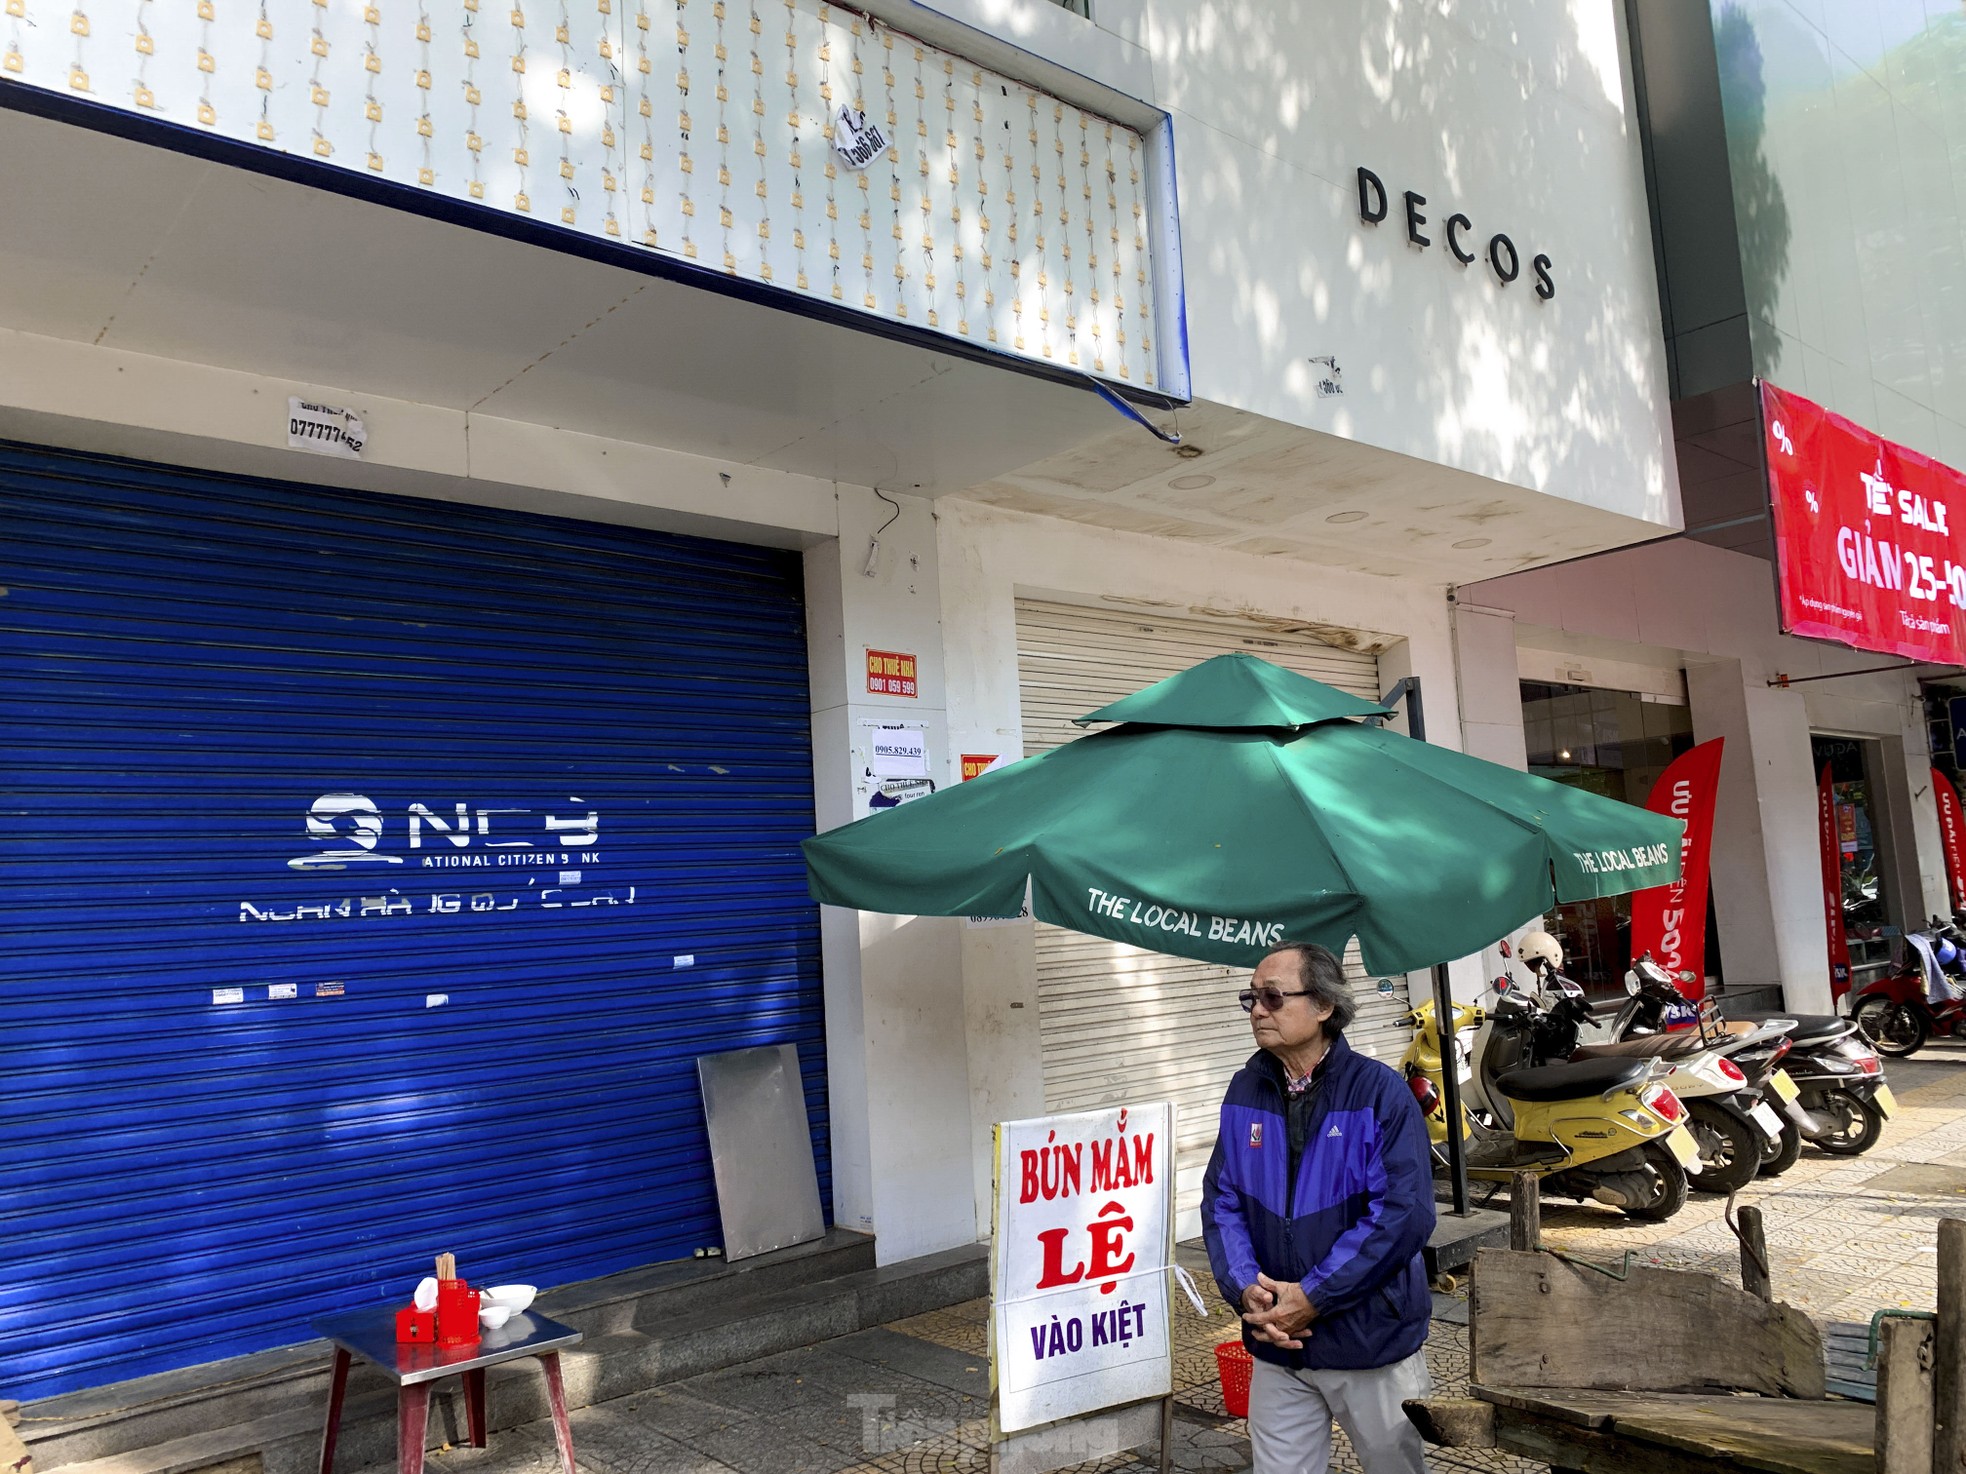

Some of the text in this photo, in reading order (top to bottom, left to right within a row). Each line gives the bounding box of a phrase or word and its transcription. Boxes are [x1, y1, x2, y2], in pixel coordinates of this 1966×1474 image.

[1357, 167, 1555, 300] DECOS
[1772, 420, 1793, 455] %
[1805, 490, 1819, 513] %
[1898, 490, 1949, 536] SALE
[869, 656, 883, 674] CHO
[901, 657, 914, 678] NHÀ
[870, 677, 915, 695] 0901 059 599
[875, 745, 922, 757] 0905.829.439
[498, 852, 555, 866] CITIZEN
[1573, 842, 1669, 873] THE LOCAL BEANS
[1088, 887, 1285, 947] THE LOCAL BEANS
[1020, 1129, 1083, 1204] BÚN
[1036, 1200, 1135, 1295] LỆ
[1030, 1299, 1147, 1361] VÀO KIỆT
